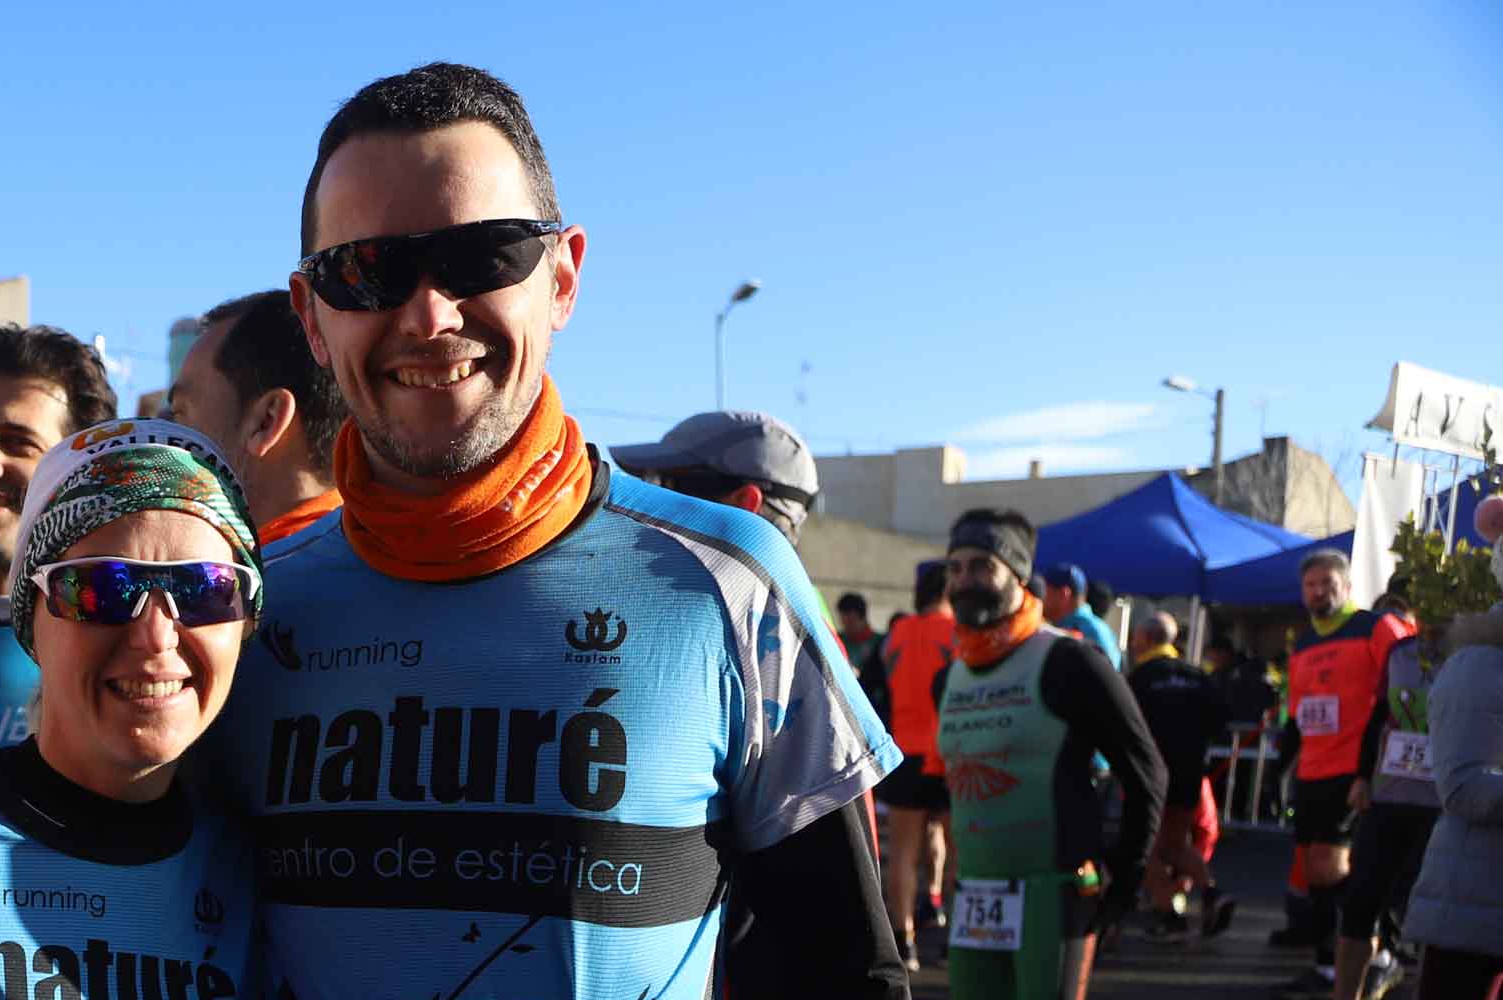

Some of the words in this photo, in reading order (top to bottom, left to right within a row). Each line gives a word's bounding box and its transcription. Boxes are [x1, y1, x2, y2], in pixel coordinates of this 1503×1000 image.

[307, 636, 424, 673] running
[265, 688, 628, 812] naturé
[265, 834, 356, 880] entro
[373, 836, 437, 879] de
[456, 840, 643, 896] estética
[3, 884, 107, 918] running
[965, 896, 1003, 925] 754
